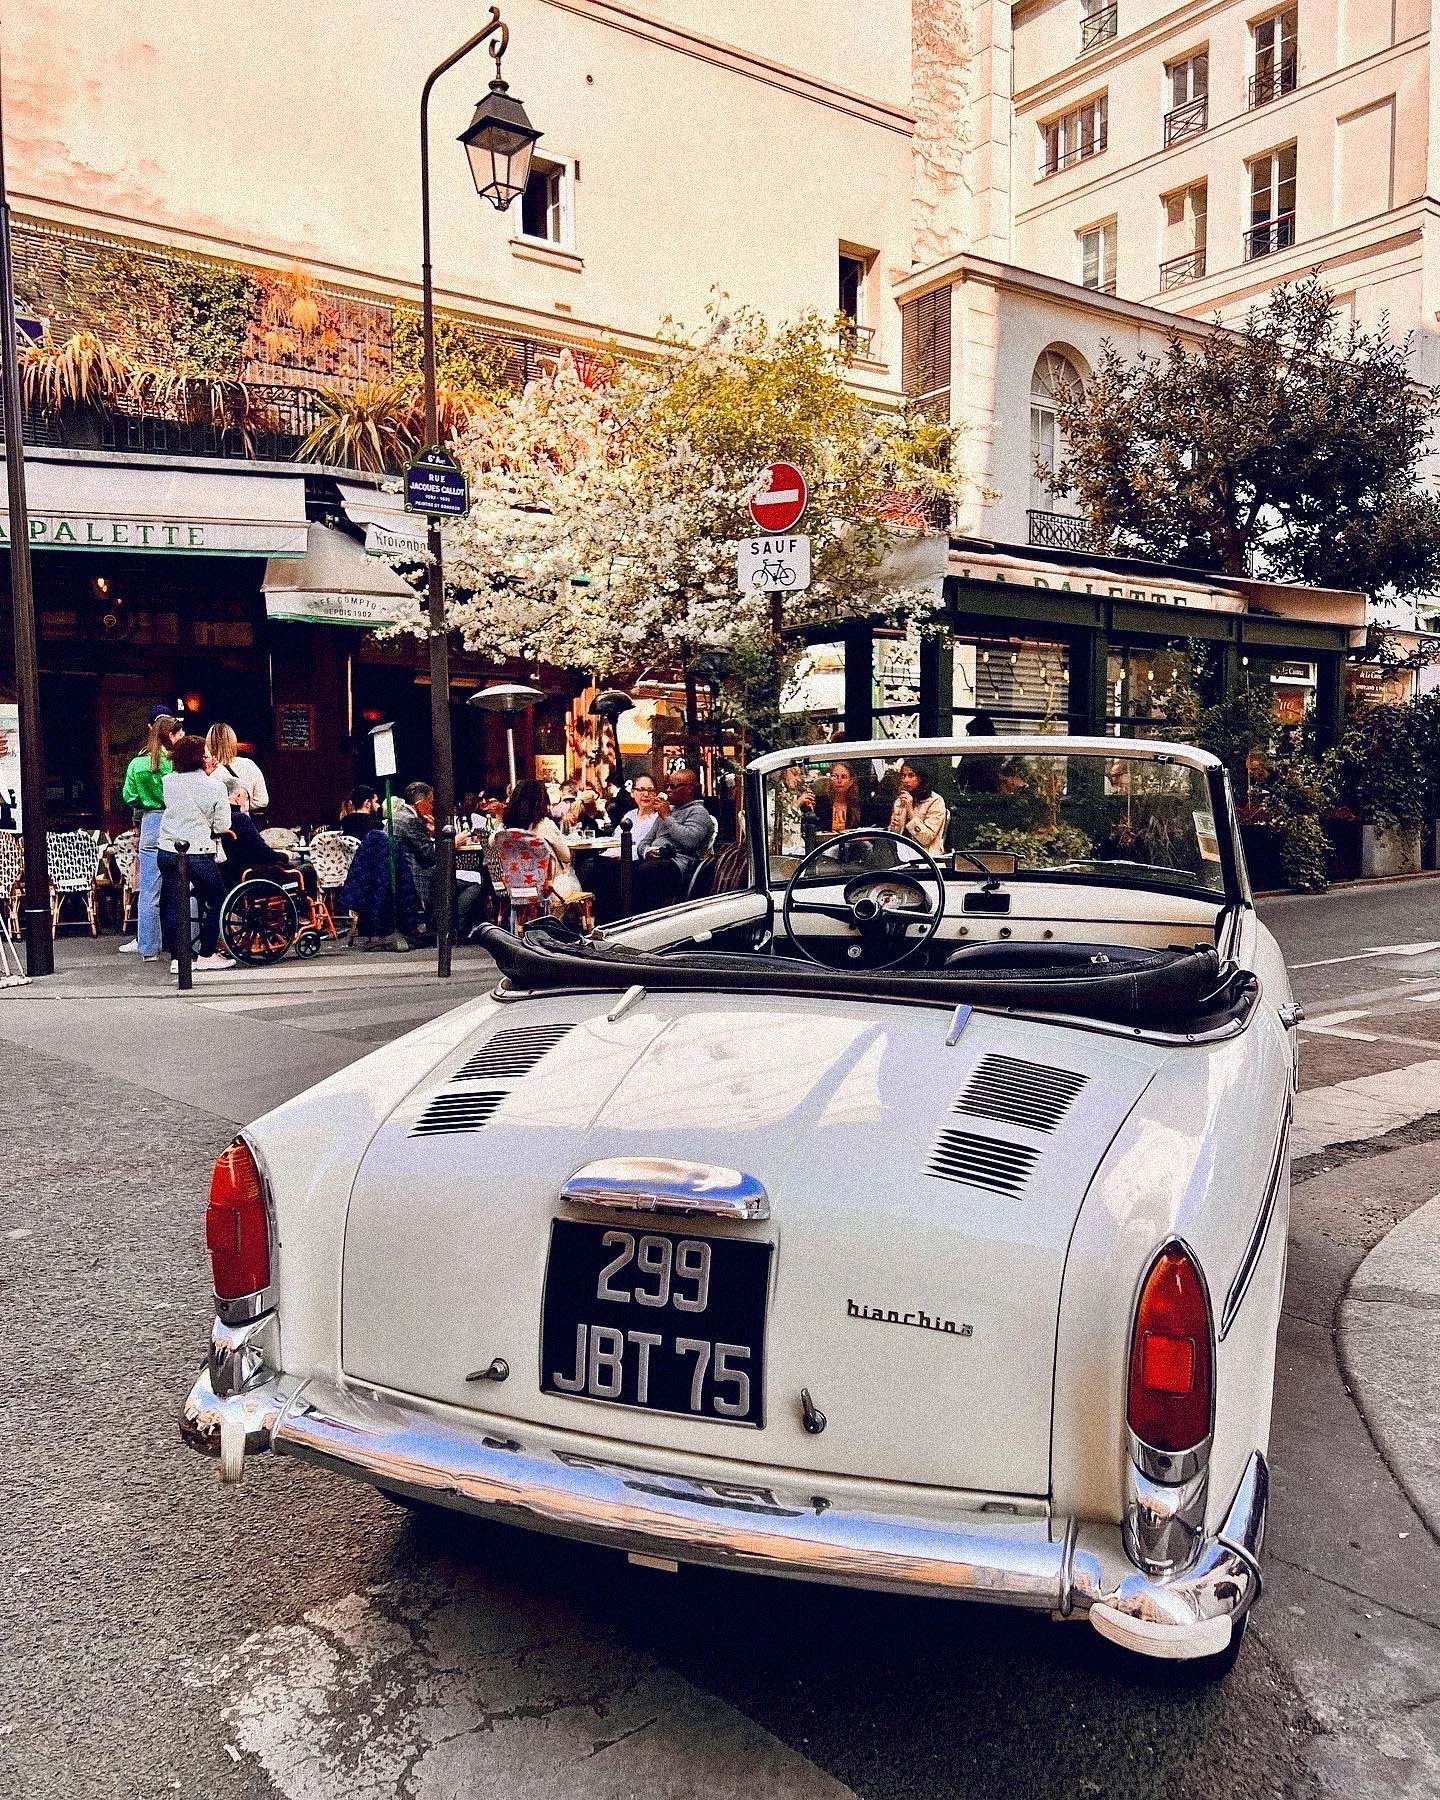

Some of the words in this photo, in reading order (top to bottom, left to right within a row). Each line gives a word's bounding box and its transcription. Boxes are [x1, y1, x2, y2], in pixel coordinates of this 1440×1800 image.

[428, 474, 445, 483] RUE
[410, 482, 440, 493] JACQUES
[441, 486, 464, 496] CALLOT
[29, 520, 205, 546] PALETTE
[751, 540, 797, 555] SAUF
[596, 1230, 712, 1313] 299
[552, 1323, 662, 1404] JBT
[675, 1337, 751, 1417] 75
